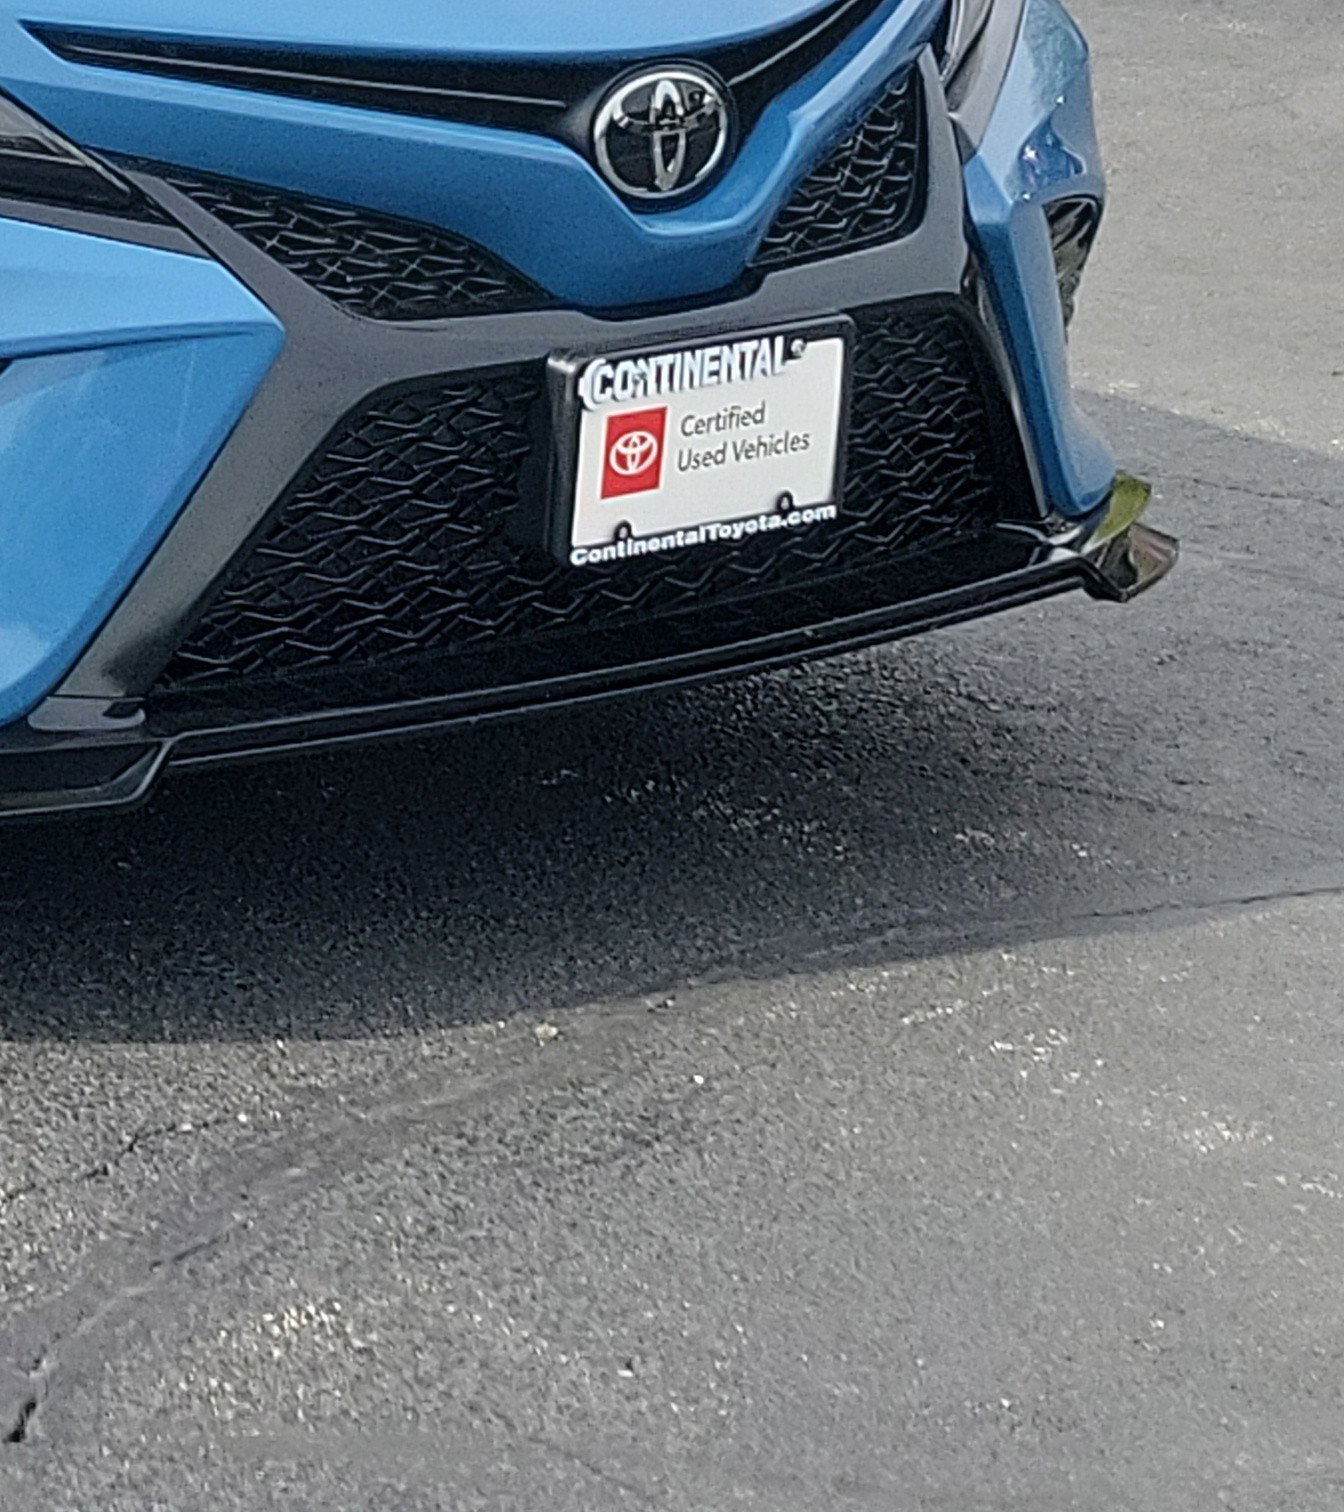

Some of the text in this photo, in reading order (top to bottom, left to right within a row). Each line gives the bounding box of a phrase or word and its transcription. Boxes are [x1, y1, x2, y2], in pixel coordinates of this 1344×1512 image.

[592, 335, 787, 404] CONTINENTAL
[680, 400, 767, 437] Certified
[677, 429, 811, 472] Used Vehicles
[569, 503, 838, 566] ContinentalToyota.com
